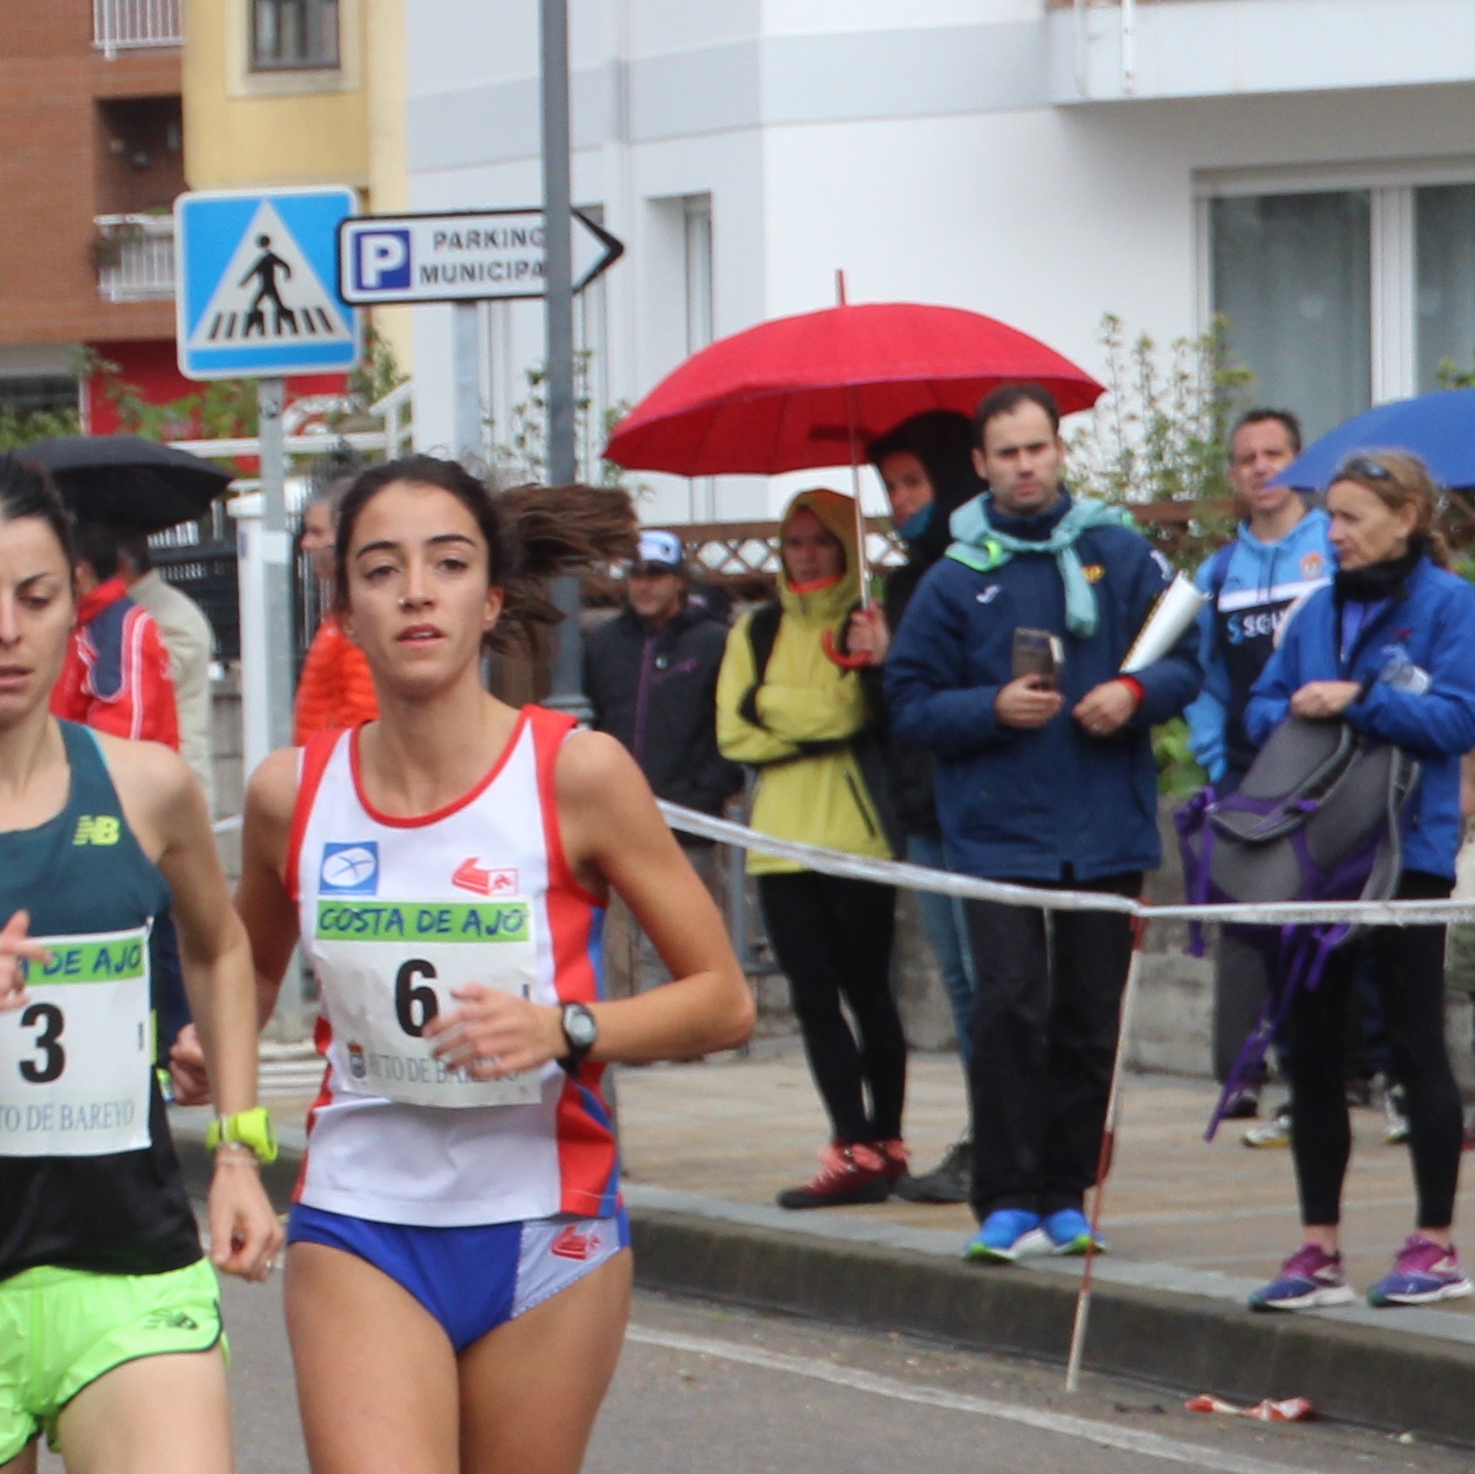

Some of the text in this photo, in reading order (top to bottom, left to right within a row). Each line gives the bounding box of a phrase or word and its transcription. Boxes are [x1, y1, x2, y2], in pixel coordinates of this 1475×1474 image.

[359, 233, 407, 289] P
[419, 260, 546, 285] MUNICIPA
[319, 907, 524, 938] COSTA DE AJO
[42, 949, 81, 976] DE
[92, 944, 142, 976] AJO
[394, 957, 439, 1038] 6
[18, 1002, 65, 1083] 3
[27, 1104, 53, 1131] DE
[60, 1099, 135, 1131] BAREYO
